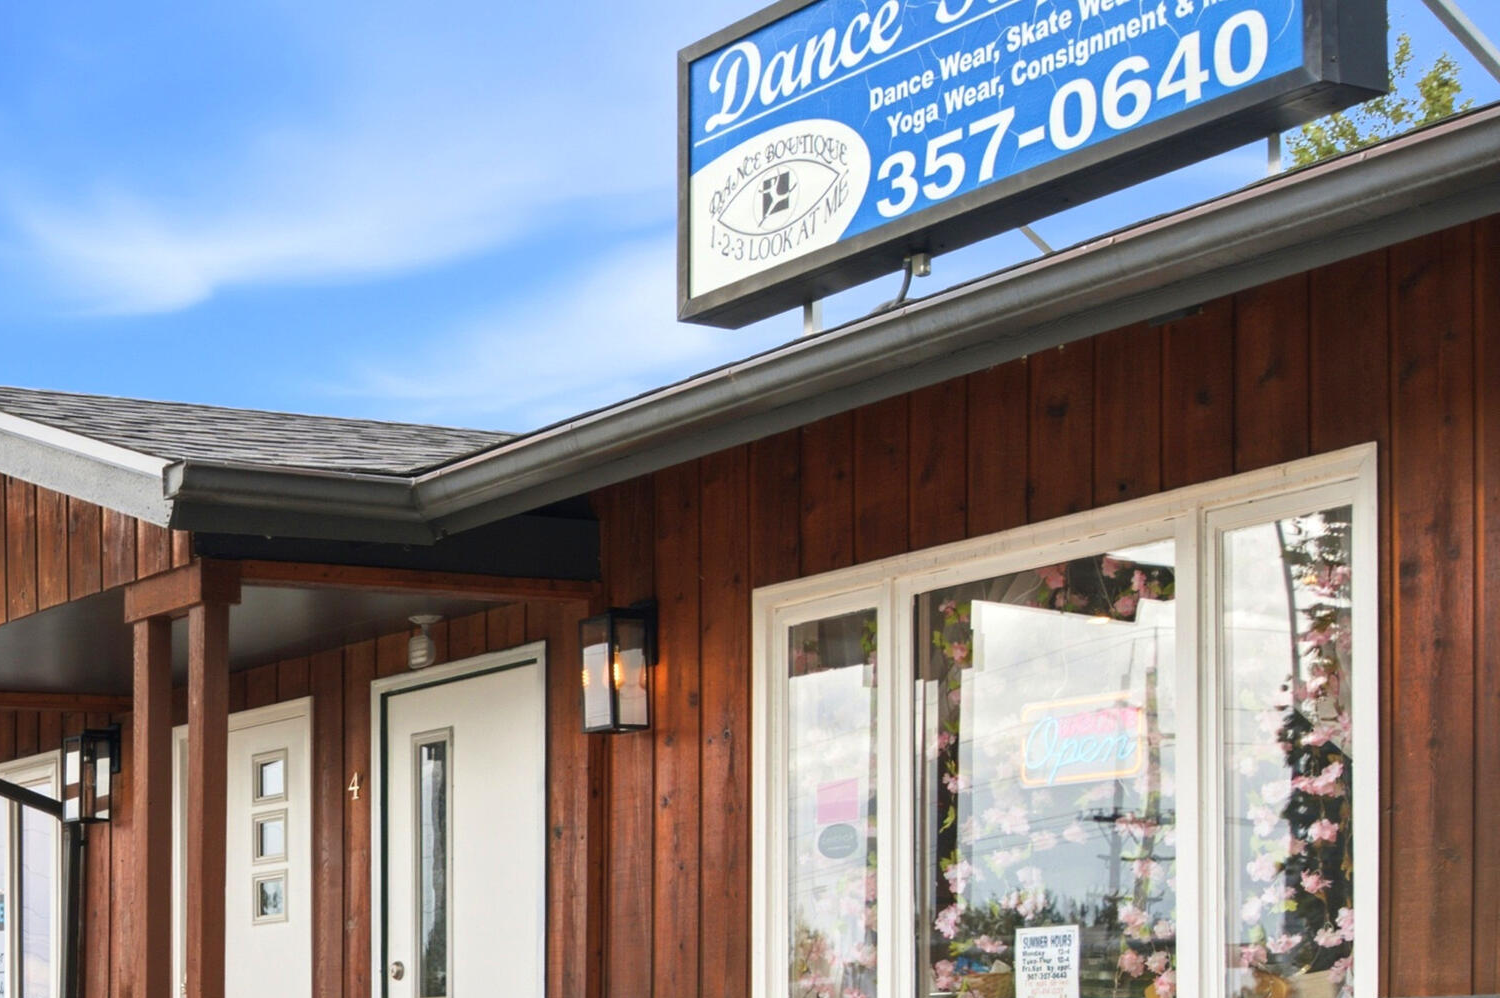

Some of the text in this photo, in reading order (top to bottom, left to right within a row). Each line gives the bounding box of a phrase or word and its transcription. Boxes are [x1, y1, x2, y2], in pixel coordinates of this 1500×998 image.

[705, 0, 902, 132] Dance
[870, 70, 934, 112] Dance
[938, 42, 1000, 81] Wear,
[1006, 9, 1073, 52] Skate
[887, 103, 939, 138] Yoga
[944, 76, 1005, 115] Wear,
[1011, 1, 1167, 86] Consignment
[1175, 0, 1194, 18] &
[876, 9, 1269, 218] 357-0640
[709, 133, 849, 219] DANCE BOUTIQUE
[749, 227, 794, 261] LOOK
[796, 207, 821, 246] AT
[823, 169, 850, 224] ME
[348, 771, 359, 800] 4
[1026, 716, 1138, 786] Open
